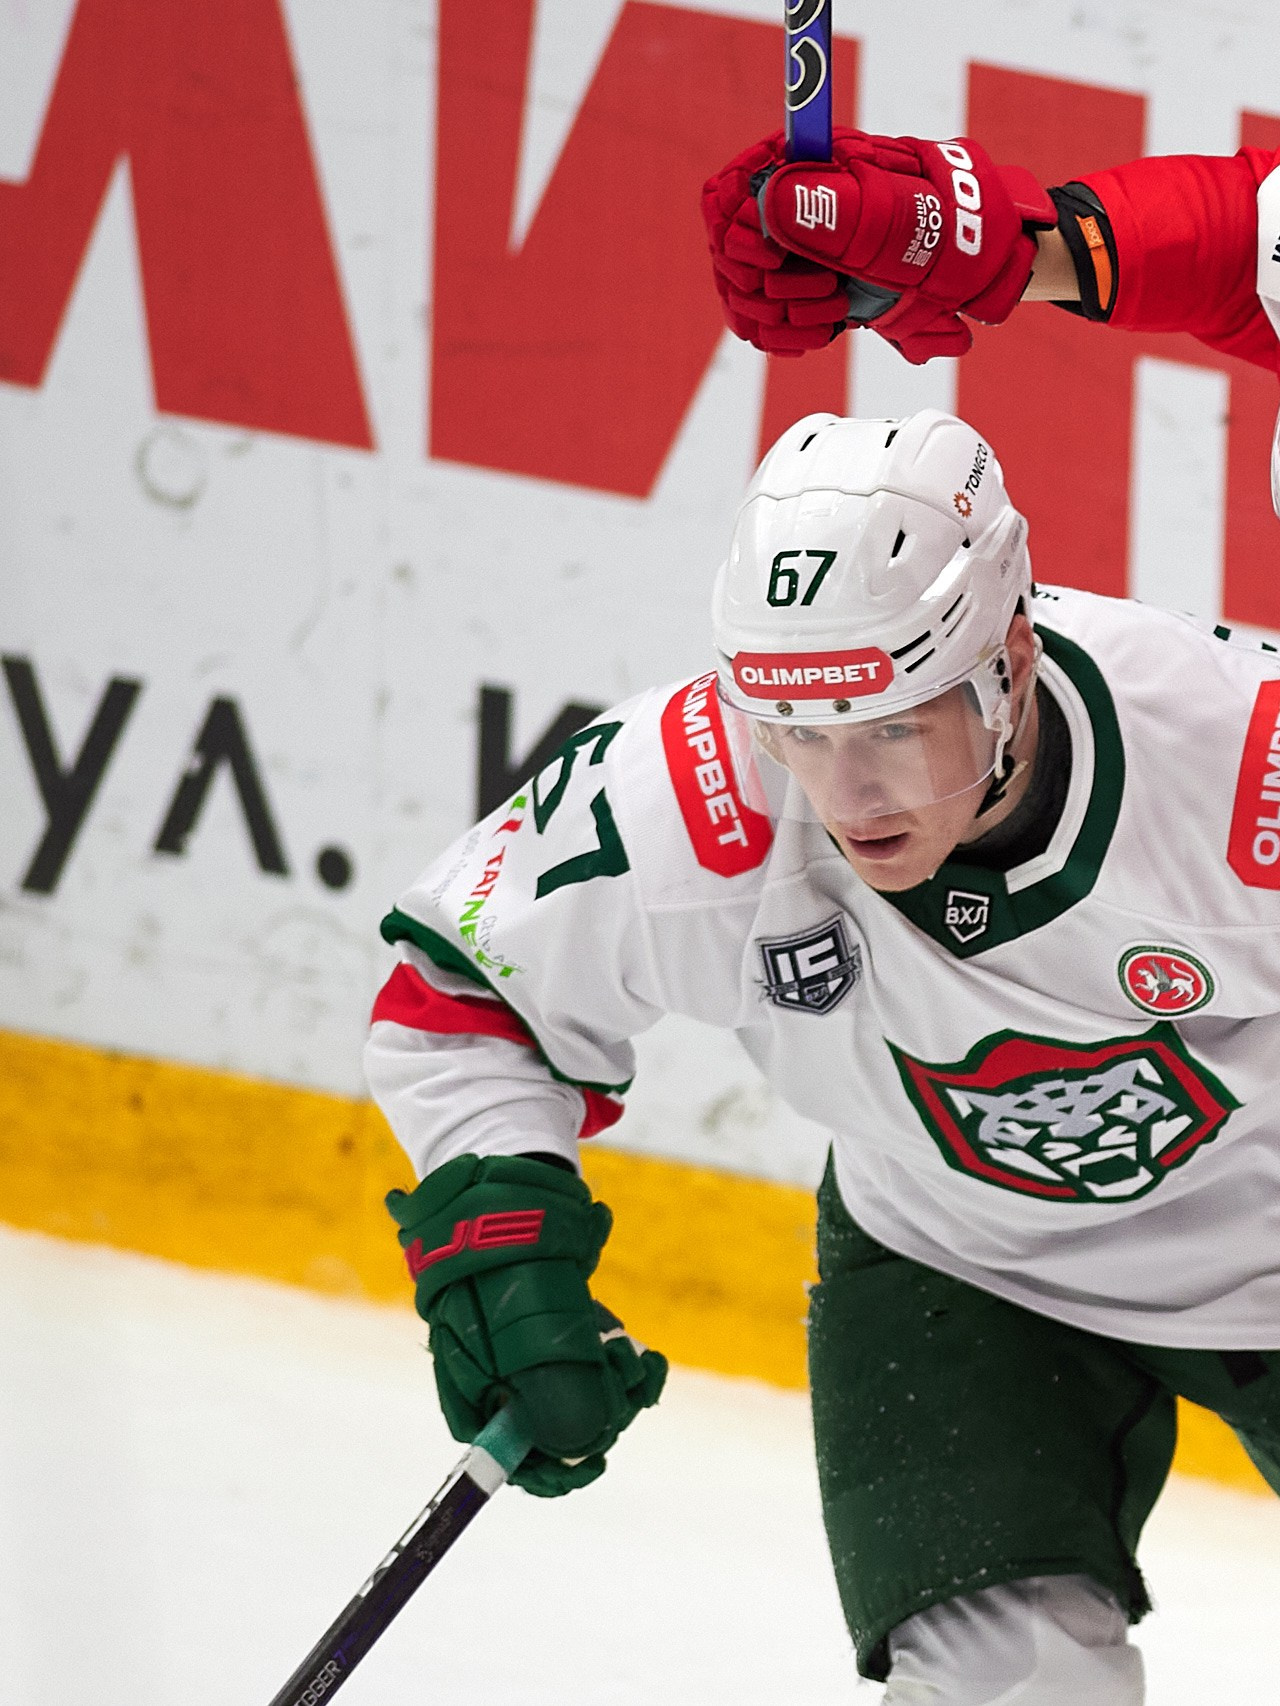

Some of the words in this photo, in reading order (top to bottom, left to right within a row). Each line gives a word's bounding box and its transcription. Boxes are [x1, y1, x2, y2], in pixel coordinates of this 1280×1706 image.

[766, 549, 838, 608] 67
[740, 661, 881, 686] OLIMPBET
[682, 671, 749, 848] OLIMPBET
[532, 720, 631, 901] 67
[944, 906, 988, 925] ВХЛ
